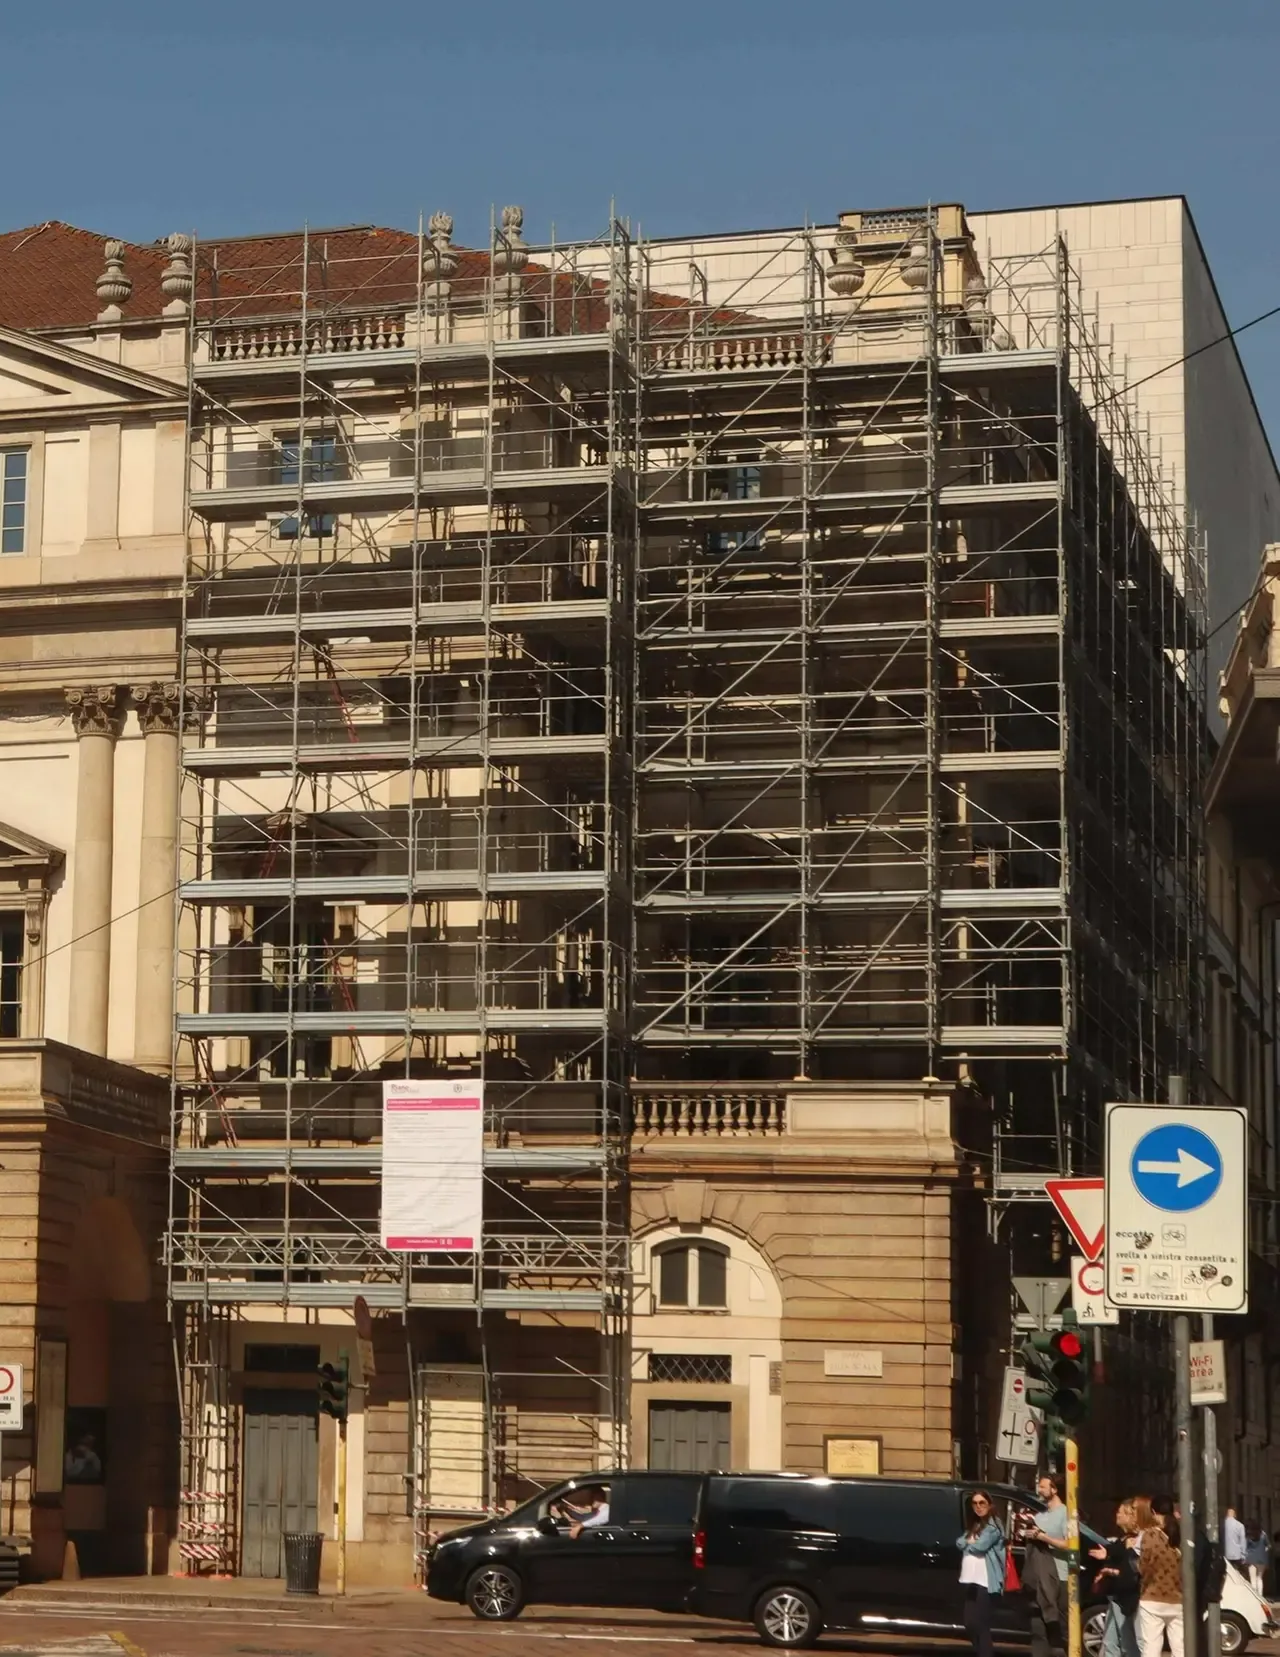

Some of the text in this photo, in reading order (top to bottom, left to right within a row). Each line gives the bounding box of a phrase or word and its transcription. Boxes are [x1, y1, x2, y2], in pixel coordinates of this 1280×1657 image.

[1116, 1251, 1140, 1259] svolta
[1151, 1253, 1182, 1261] sinistra
[1184, 1254, 1227, 1263] consentita
[1115, 1291, 1188, 1301] ed autorizzati
[1190, 1355, 1213, 1367] Wi-Fi
[1190, 1368, 1214, 1378] area
